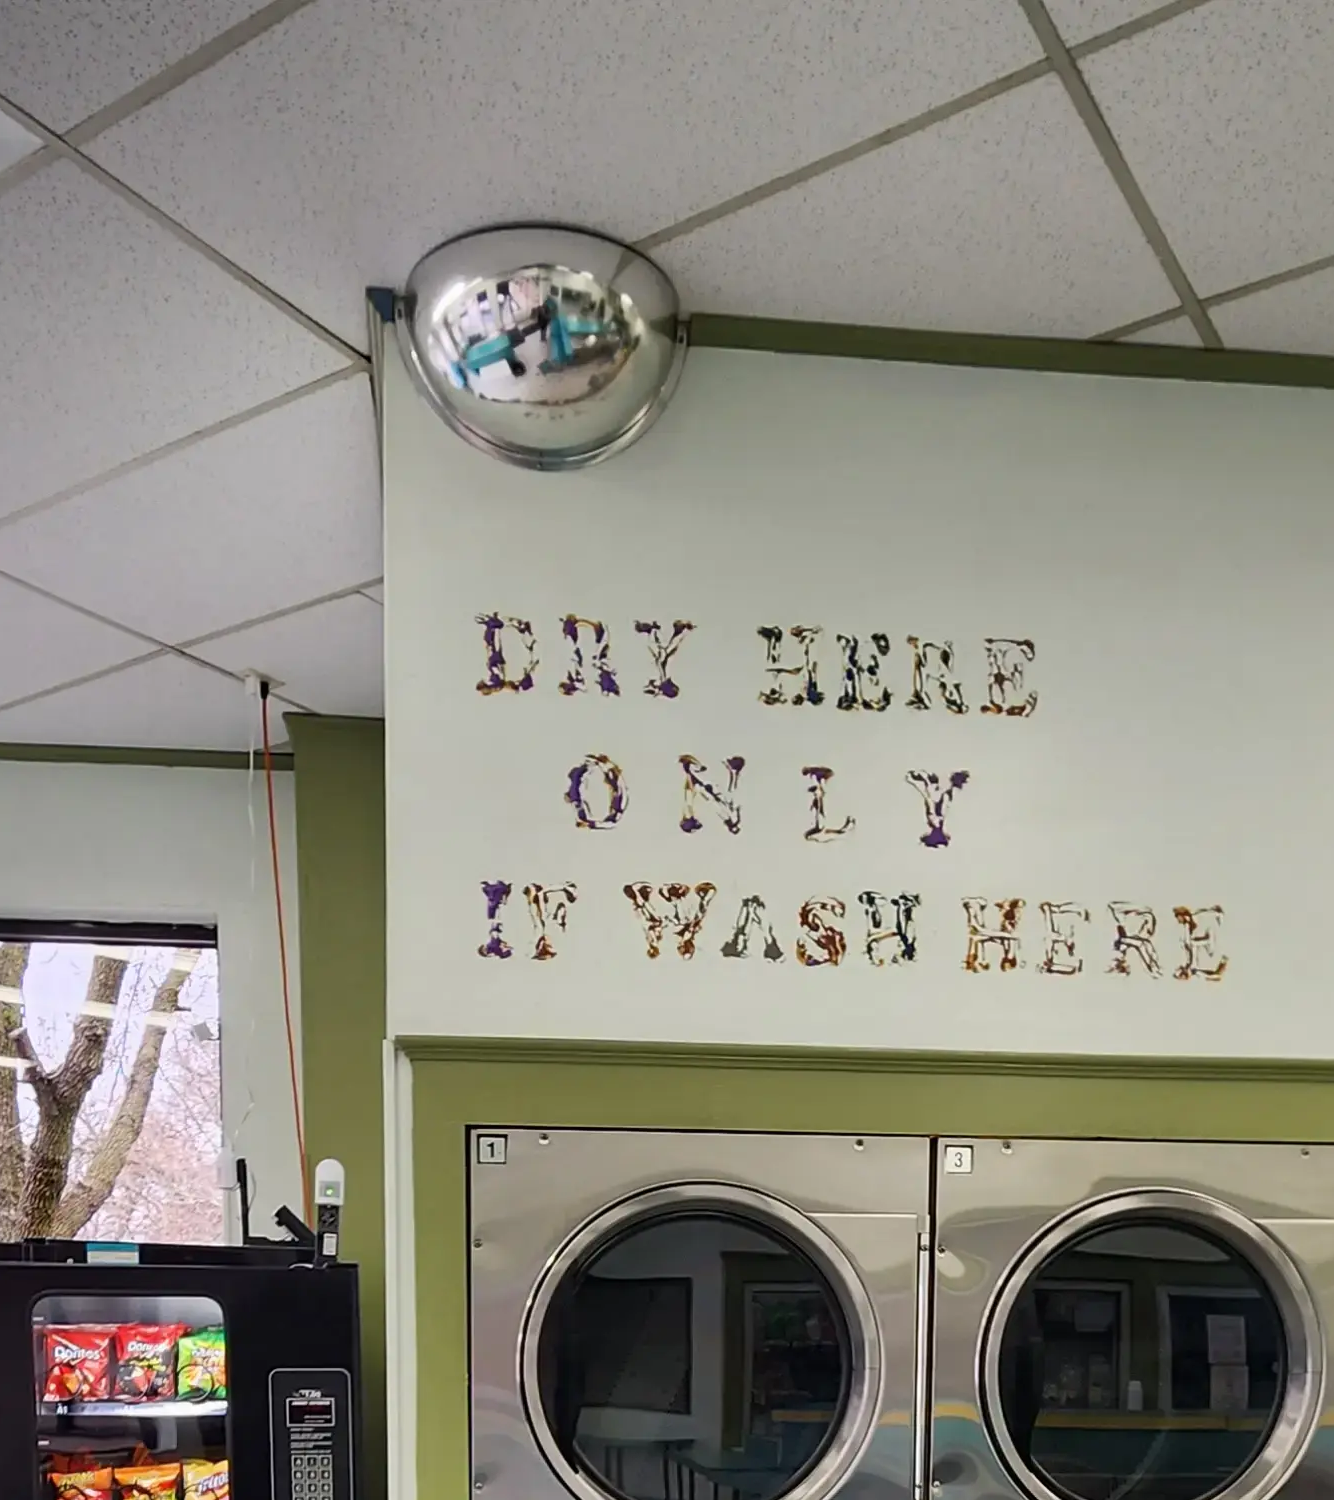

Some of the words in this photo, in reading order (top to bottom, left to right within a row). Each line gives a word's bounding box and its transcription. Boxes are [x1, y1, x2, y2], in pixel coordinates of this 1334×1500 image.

[476, 612, 697, 698] DRY
[757, 624, 1040, 717] HERE
[477, 880, 578, 961] IF
[623, 881, 923, 968] WASH
[961, 896, 1229, 981] HERE
[486, 1141, 496, 1158] 1
[954, 1151, 964, 1168] 3
[54, 1346, 101, 1360] Doritos
